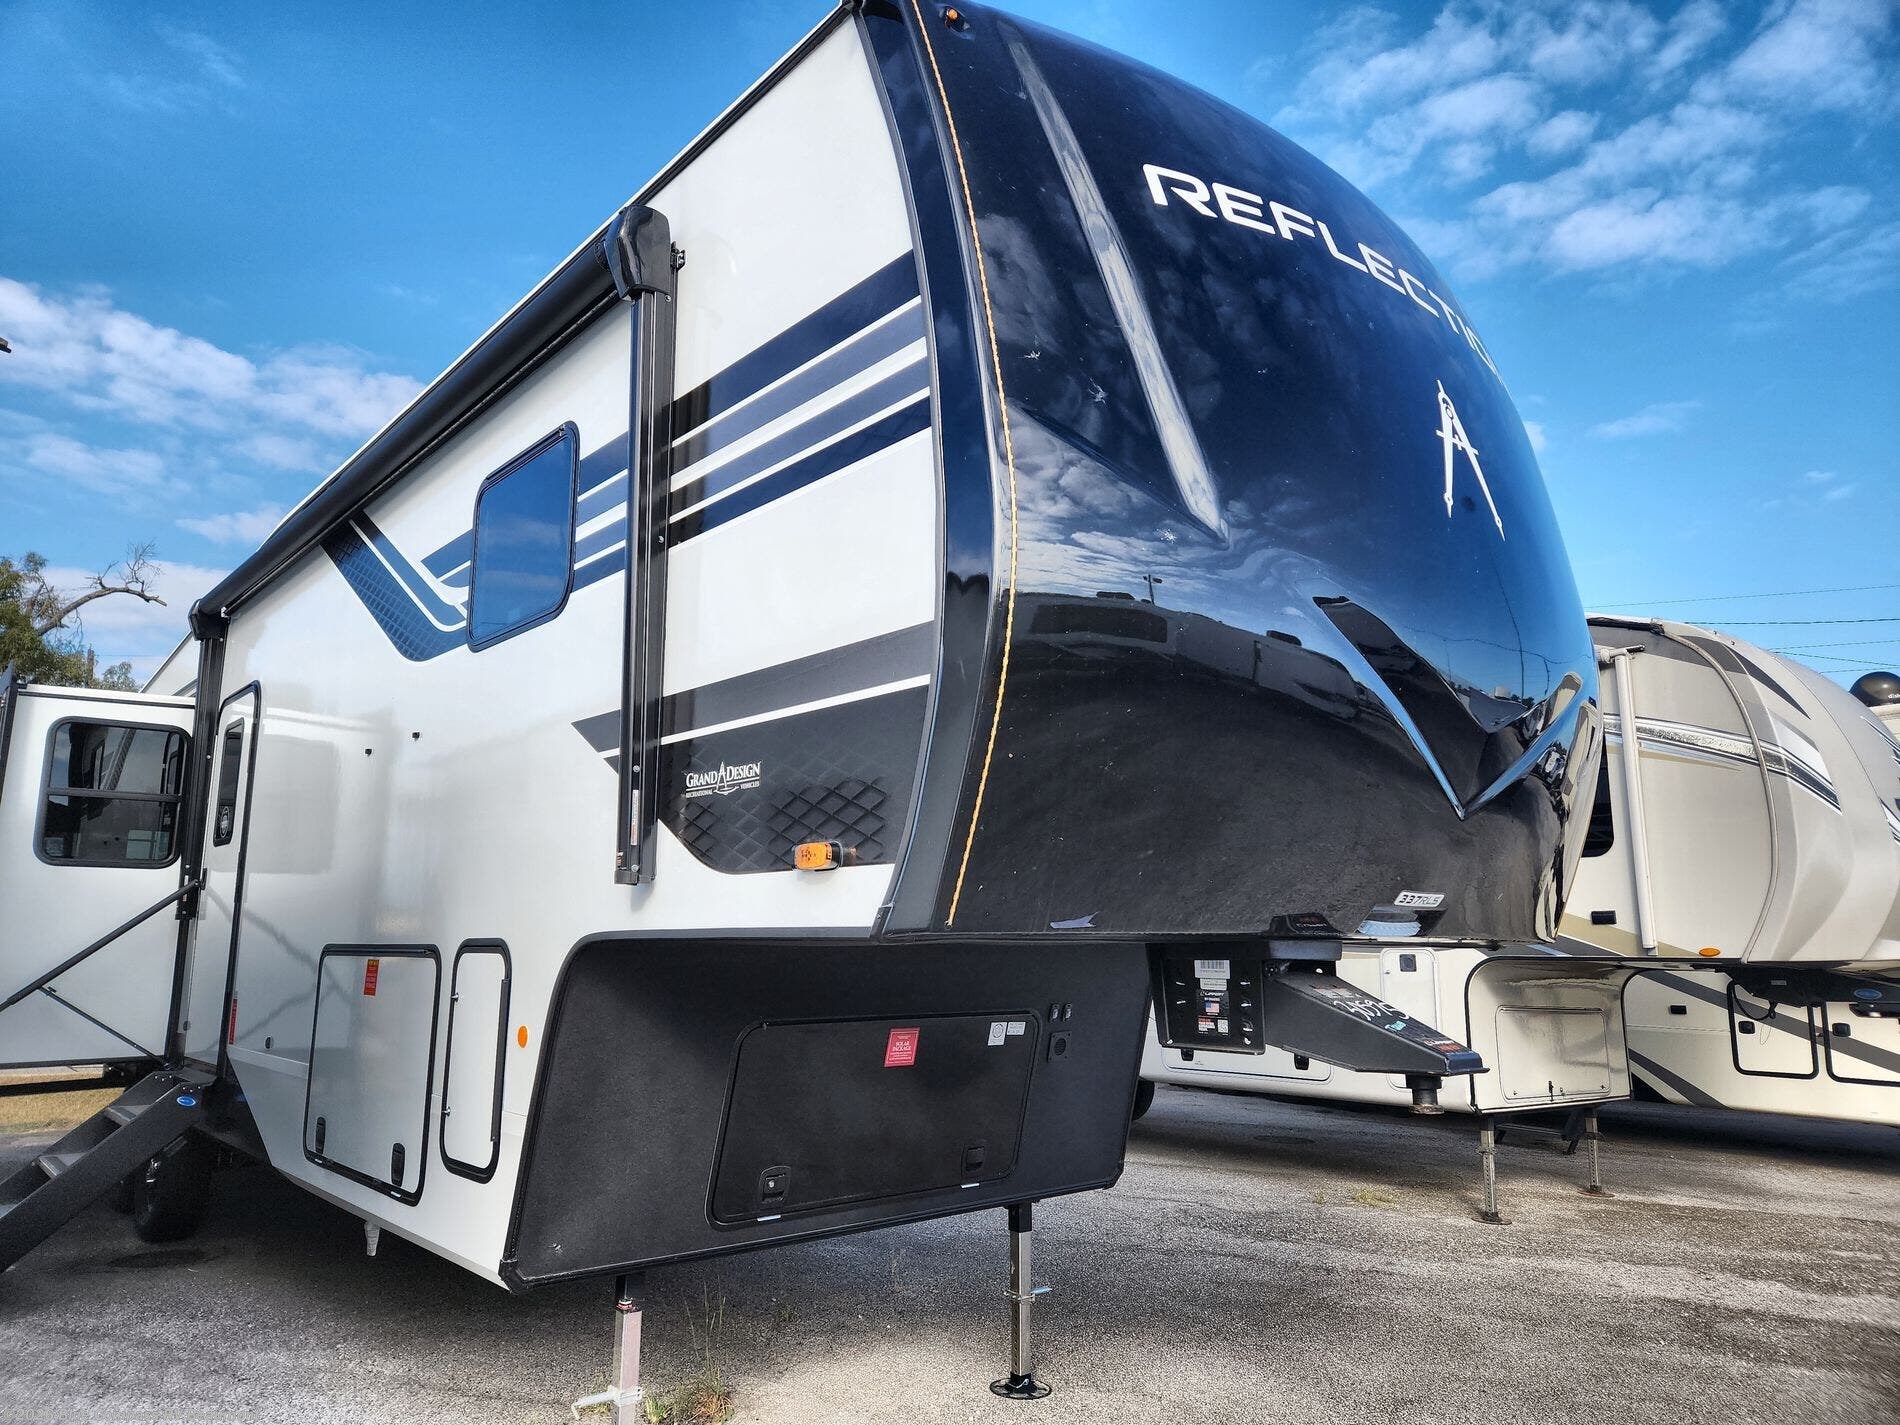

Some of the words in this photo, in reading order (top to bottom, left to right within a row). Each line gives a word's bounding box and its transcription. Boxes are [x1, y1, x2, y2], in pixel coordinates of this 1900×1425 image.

[1142, 163, 1510, 392] REFLECTIO
[685, 770, 718, 788] GRAND
[726, 761, 761, 781] DESIGN
[1399, 894, 1440, 905] 337RLS
